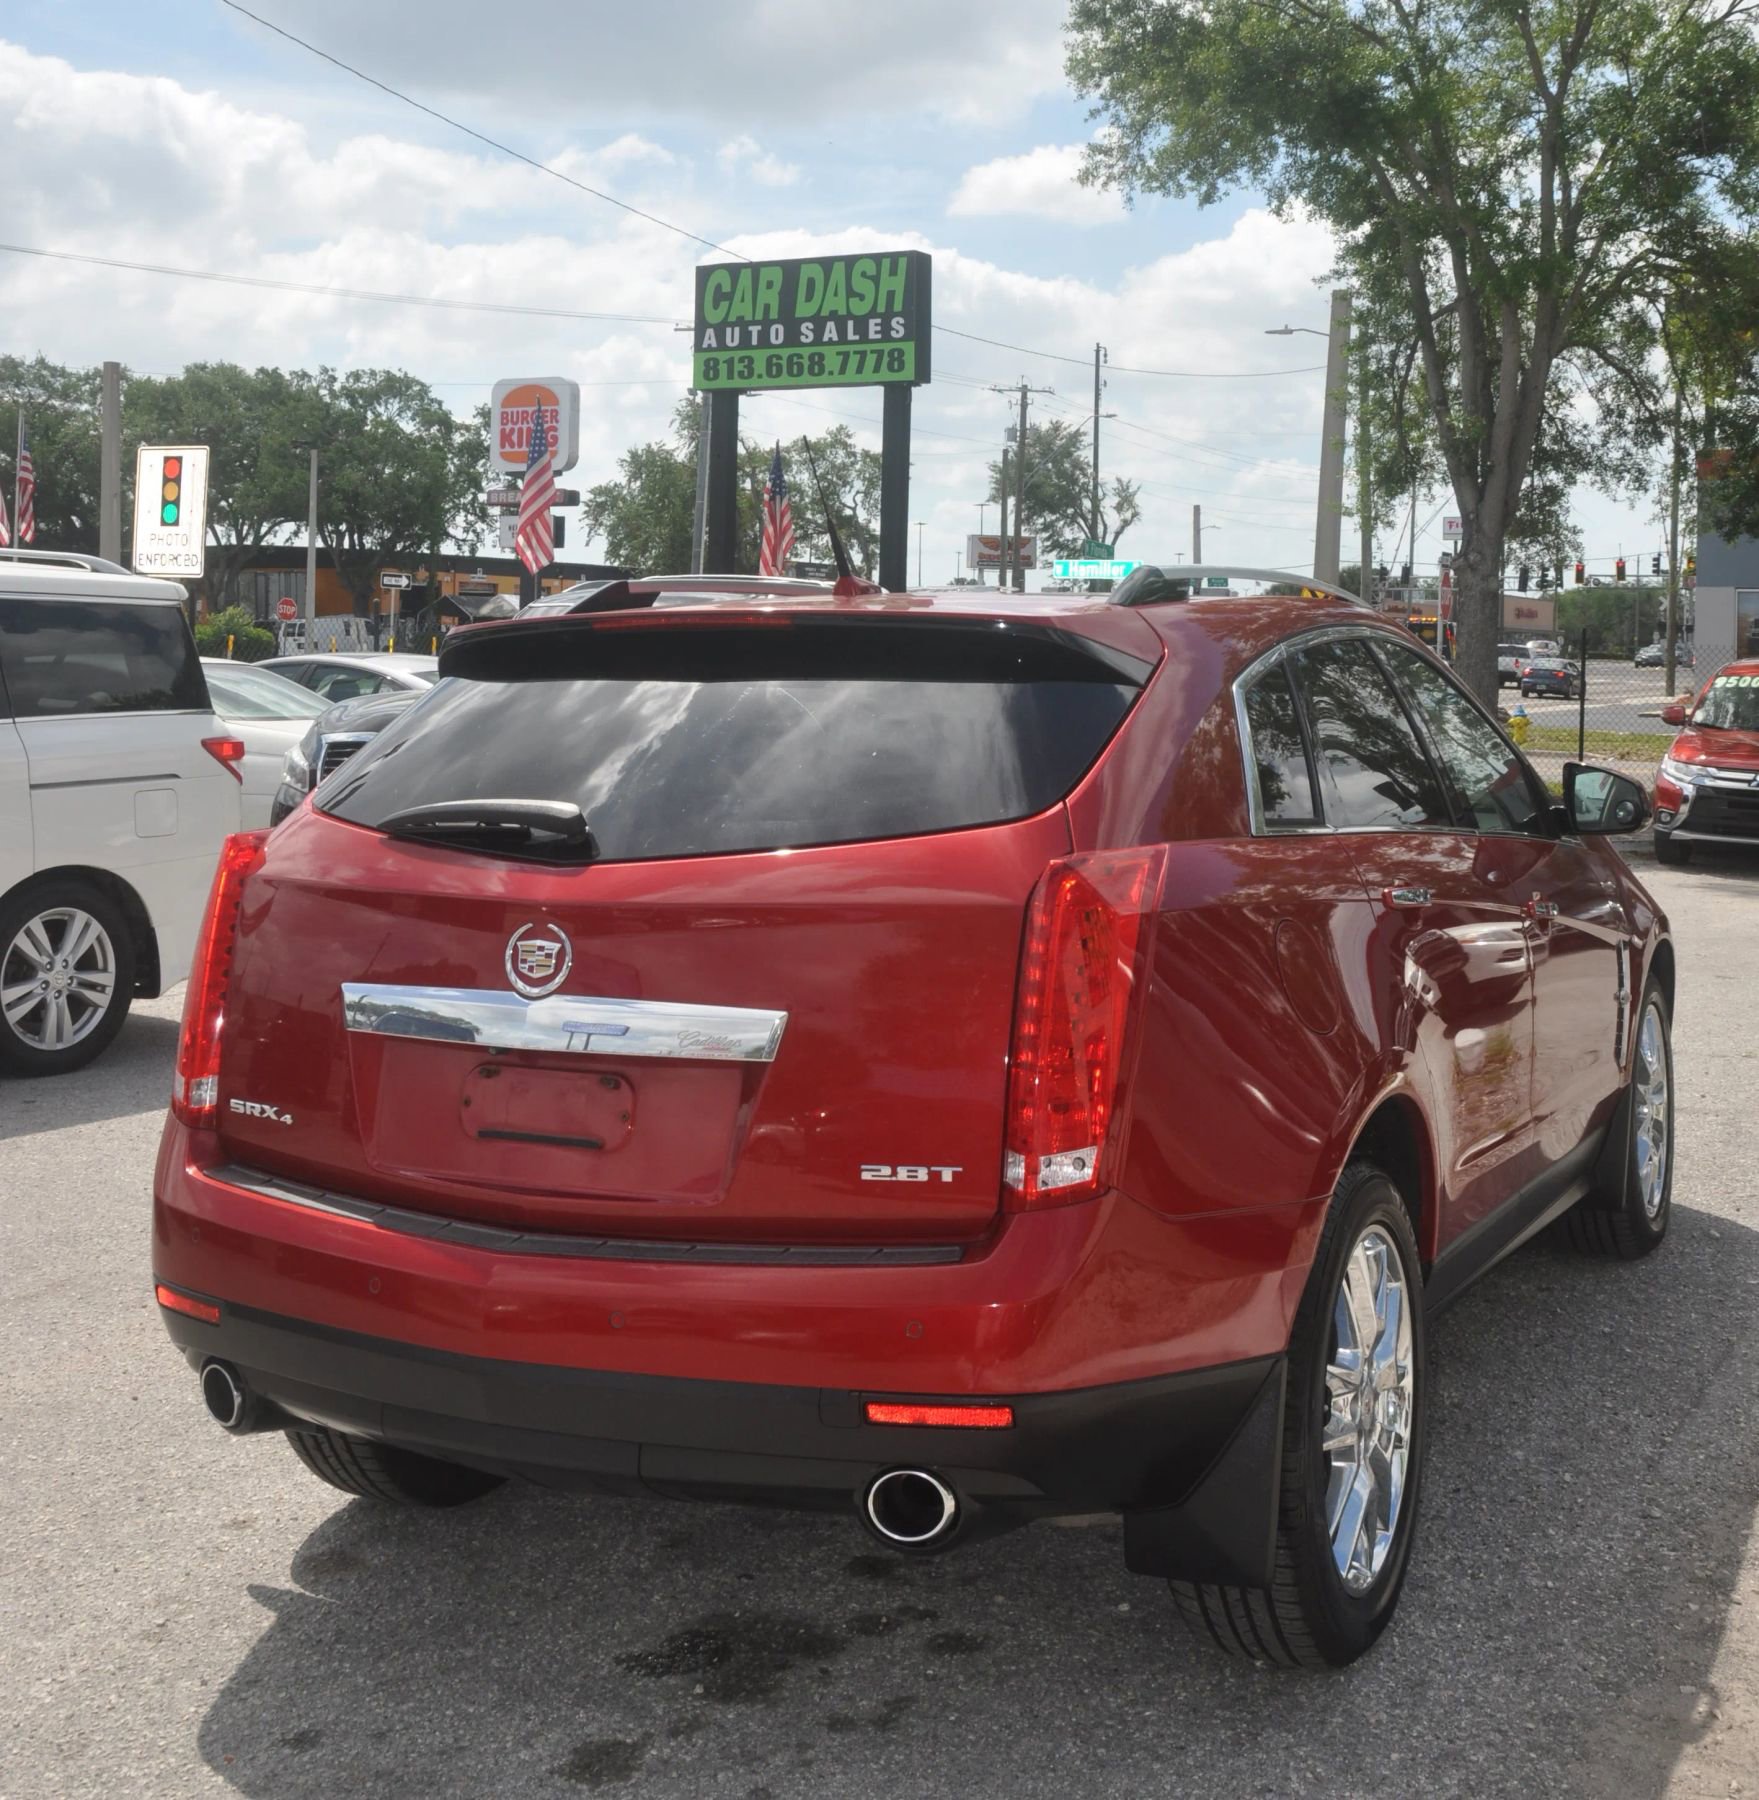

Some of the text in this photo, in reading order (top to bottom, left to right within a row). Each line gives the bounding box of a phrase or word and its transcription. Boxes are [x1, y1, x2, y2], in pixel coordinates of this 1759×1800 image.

[703, 256, 908, 325] CAR DASH
[702, 316, 905, 349] AUTO SALES
[702, 347, 906, 382] 813.668.7778
[500, 425, 559, 450] KIG
[150, 533, 189, 547] PHOTO
[138, 553, 199, 567] ENFORCED
[278, 604, 296, 615] STOP
[860, 1164, 963, 1183] 2.8T
